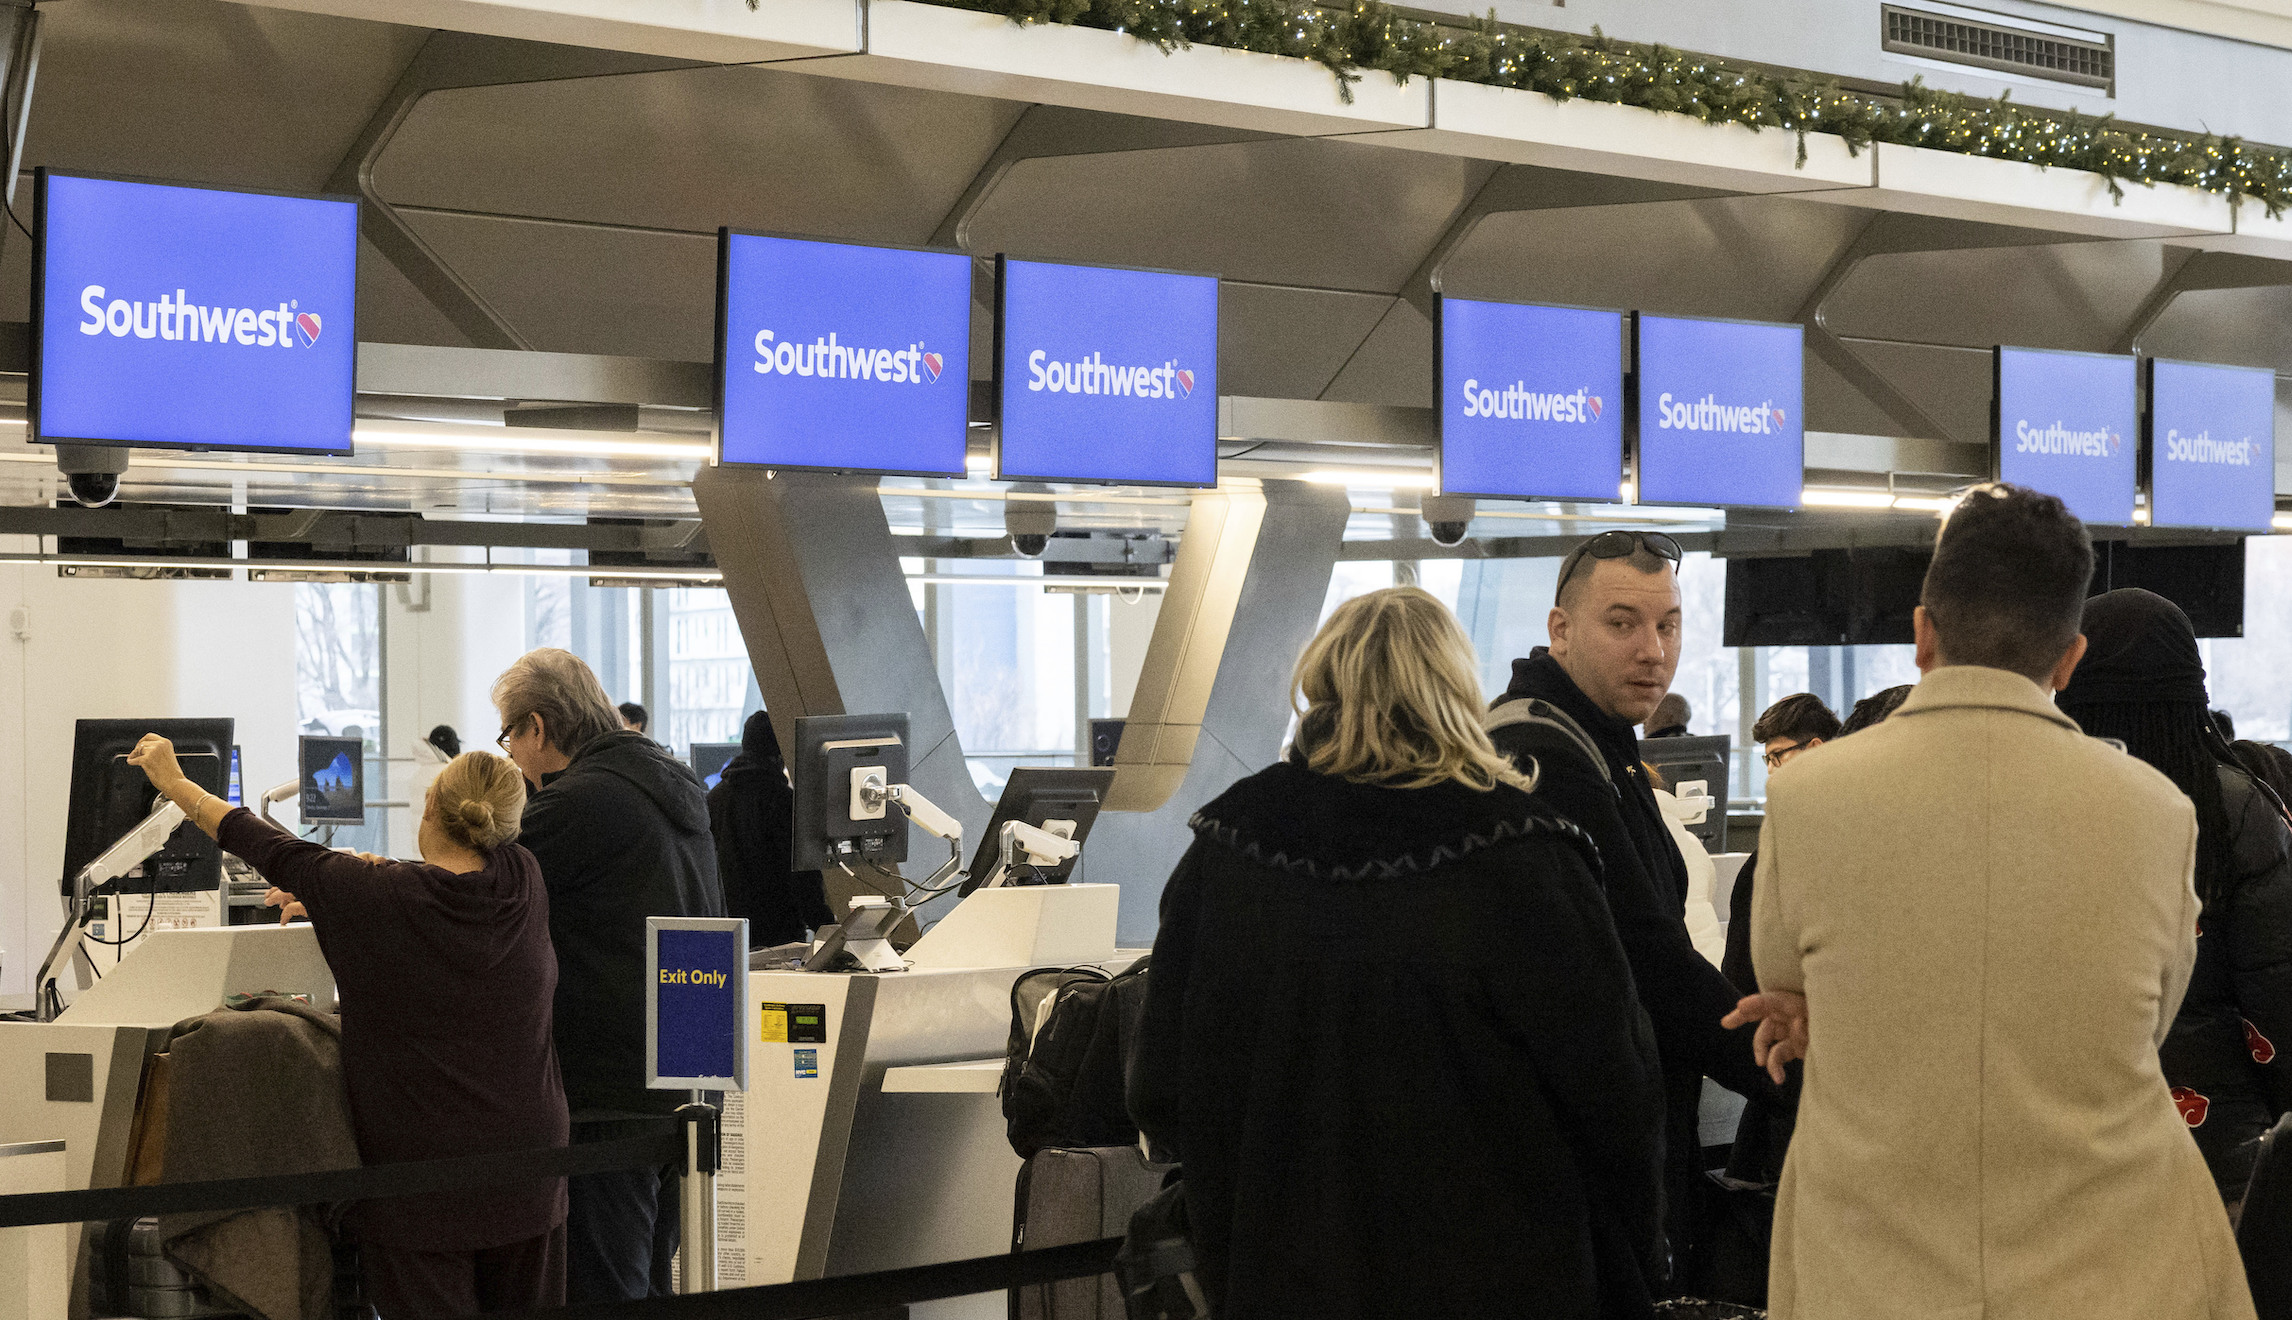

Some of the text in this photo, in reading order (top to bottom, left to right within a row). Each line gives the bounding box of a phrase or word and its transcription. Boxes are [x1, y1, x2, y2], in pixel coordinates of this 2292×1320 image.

[80, 285, 294, 348] Southwest
[754, 329, 922, 384] Southwest
[1029, 350, 1175, 400] Southwest
[1463, 379, 1586, 424] Southwest
[1660, 392, 1770, 435] Southwest
[2016, 420, 2108, 457] Southwest
[2167, 430, 2250, 466] Southwest
[659, 969, 727, 989] Exit Only
